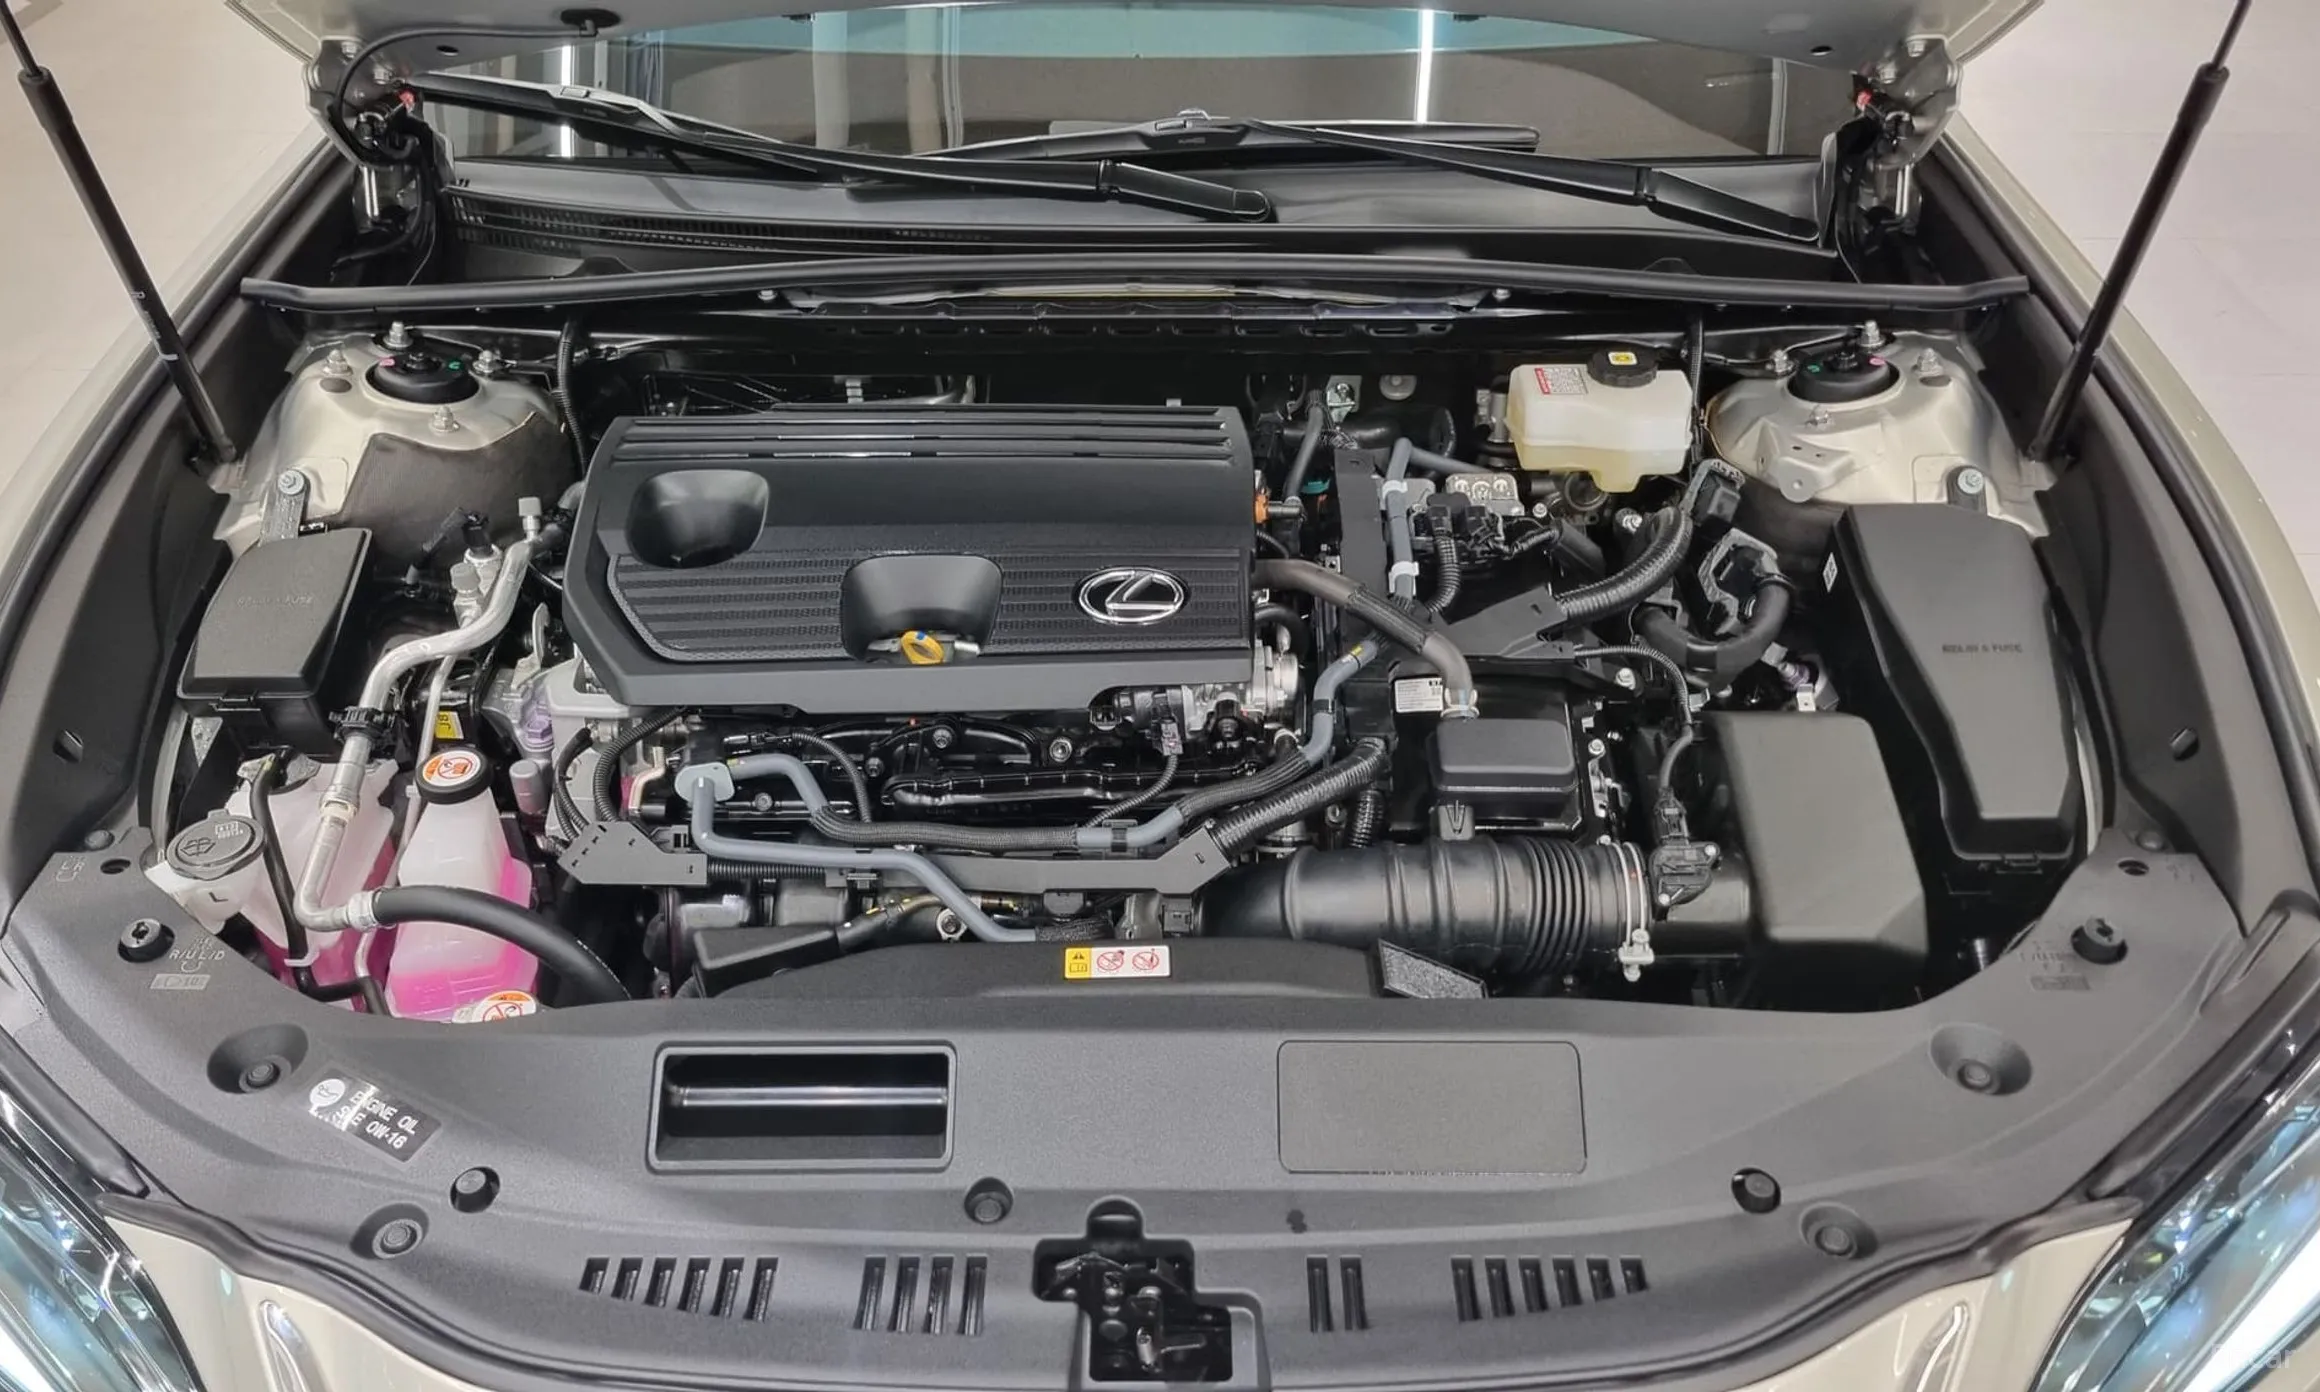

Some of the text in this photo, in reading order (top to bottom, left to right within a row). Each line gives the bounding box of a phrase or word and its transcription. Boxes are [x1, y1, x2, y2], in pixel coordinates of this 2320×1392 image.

[335, 1105, 409, 1150] SE 0W-16
[397, 1115, 420, 1135] OIL
